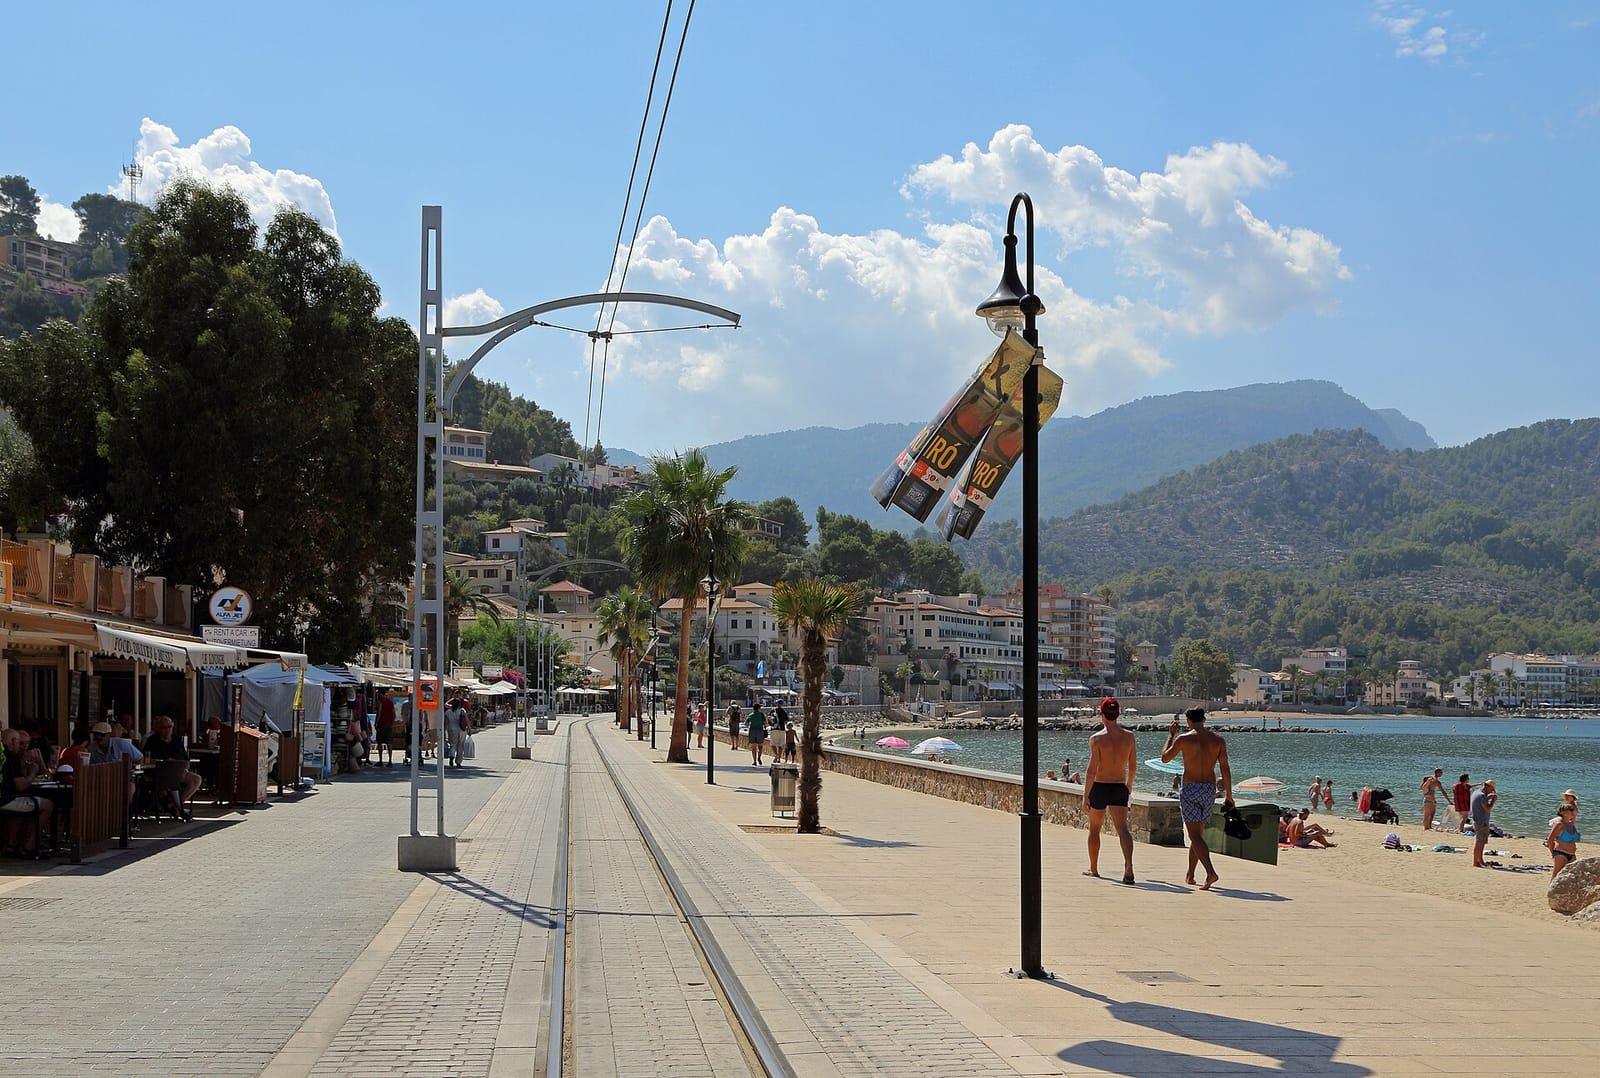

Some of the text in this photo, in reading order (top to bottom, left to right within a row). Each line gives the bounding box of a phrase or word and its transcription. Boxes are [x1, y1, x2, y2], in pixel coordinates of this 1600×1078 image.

[922, 434, 962, 470] IRÓ
[213, 628, 248, 637] RENT A CAR
